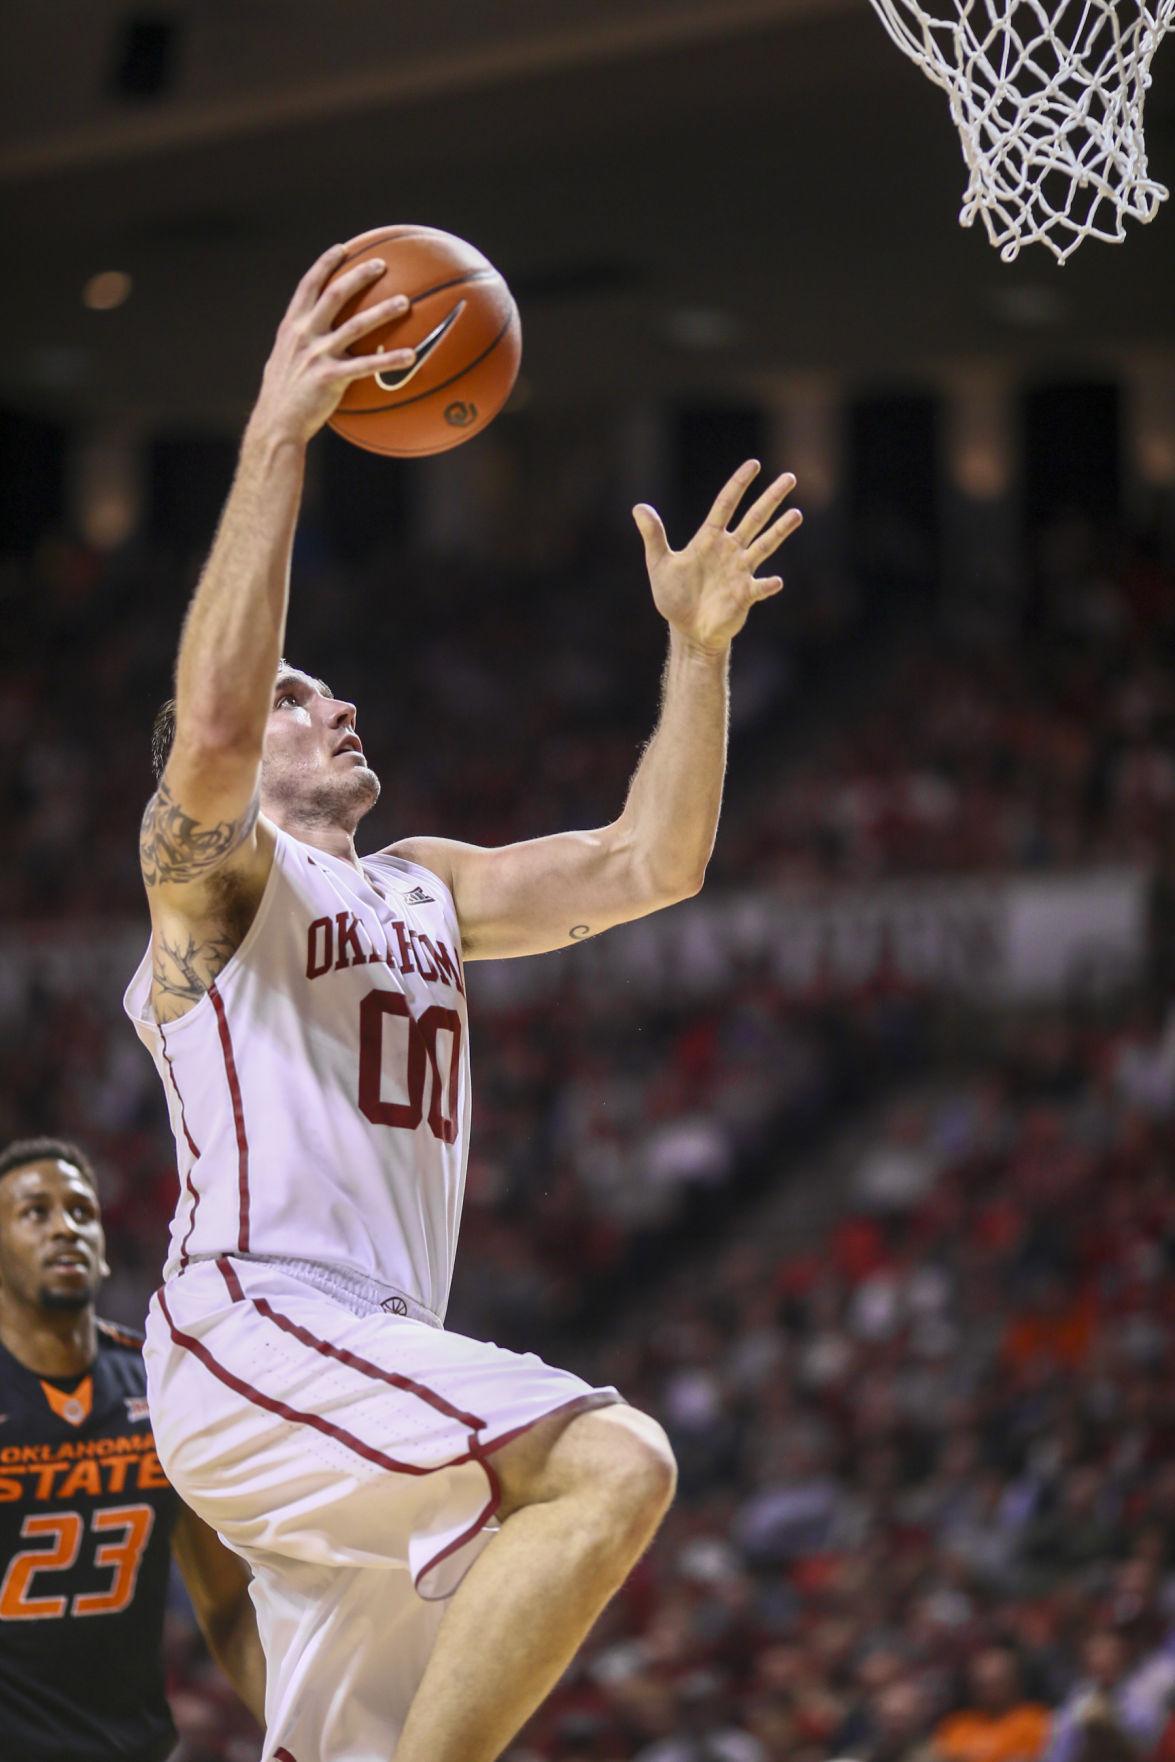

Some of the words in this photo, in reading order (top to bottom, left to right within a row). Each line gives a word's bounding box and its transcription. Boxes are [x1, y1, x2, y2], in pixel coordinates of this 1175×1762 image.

[359, 989, 461, 1144] 00
[0, 1453, 170, 1502] STATE
[0, 1503, 154, 1620] 23
